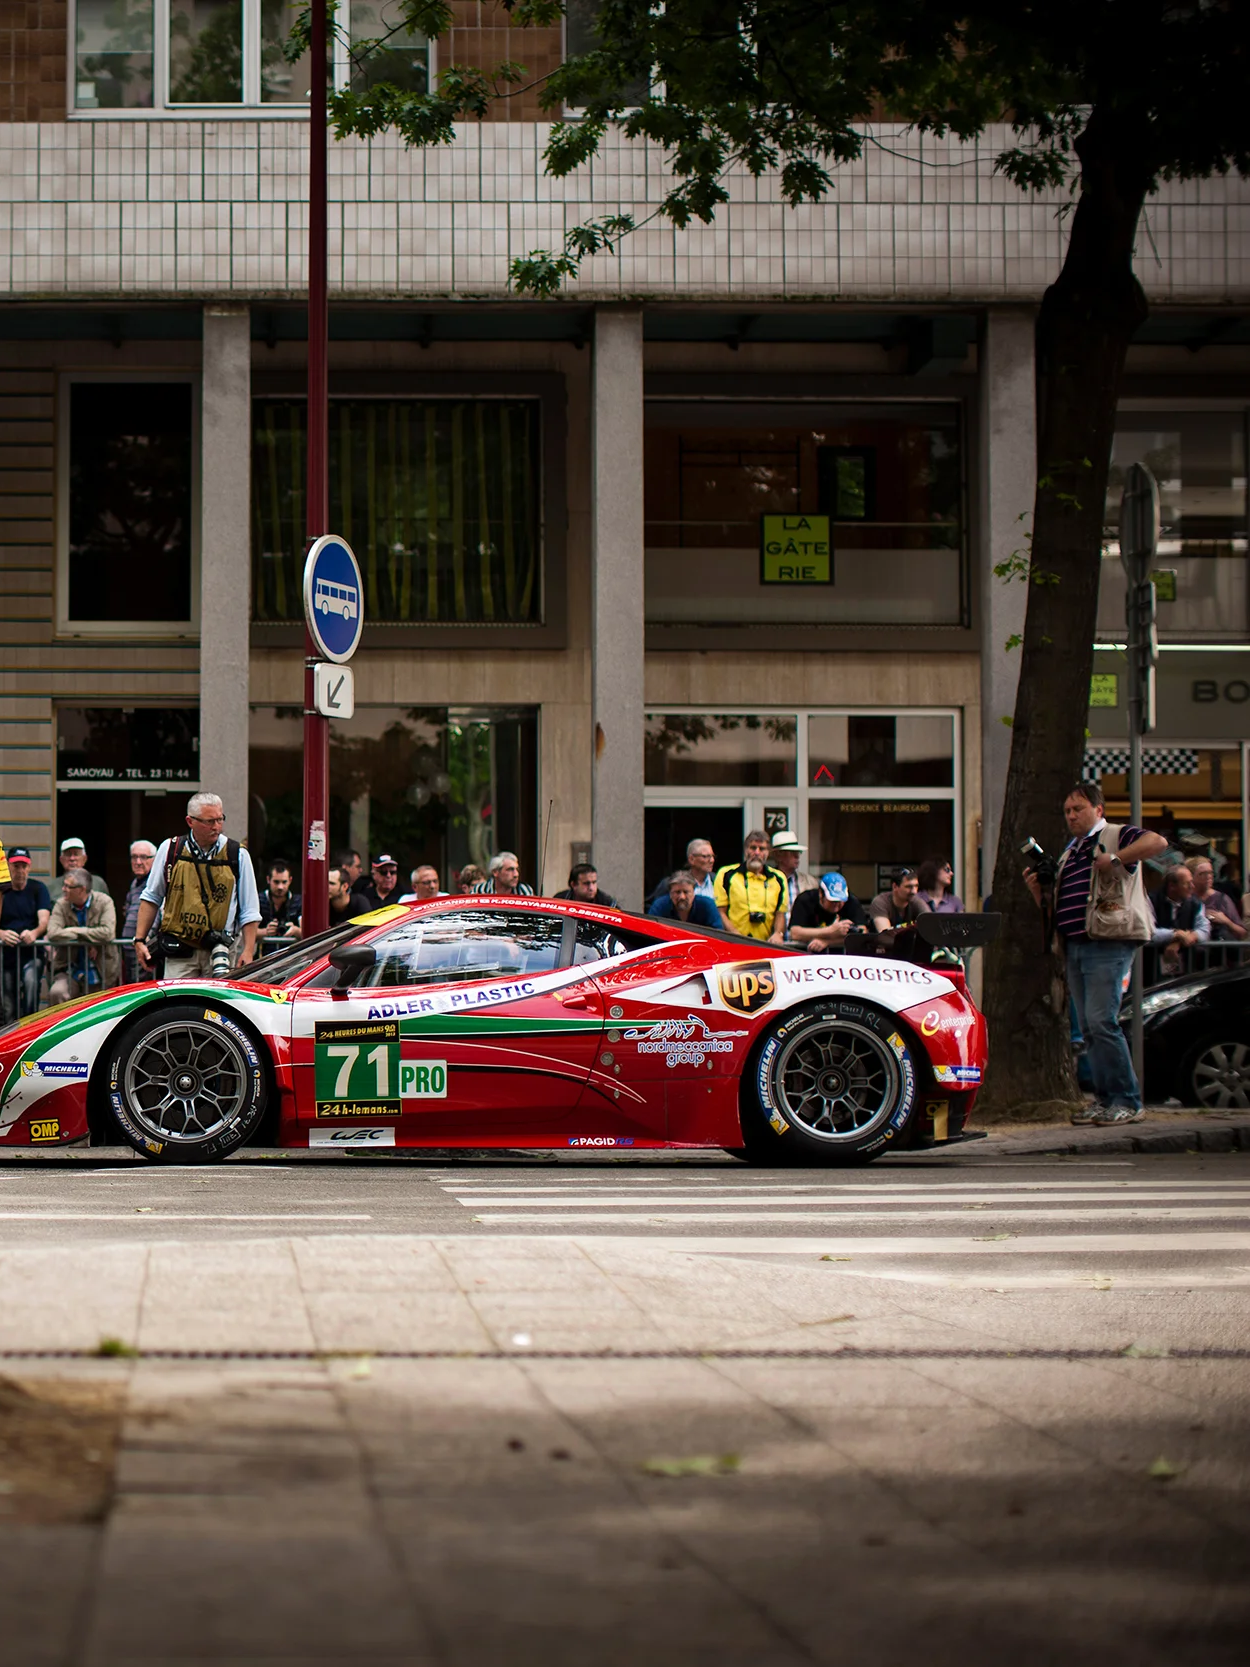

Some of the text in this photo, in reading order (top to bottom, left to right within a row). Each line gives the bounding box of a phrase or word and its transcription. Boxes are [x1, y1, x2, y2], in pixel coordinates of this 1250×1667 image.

[783, 517, 811, 530] LA
[766, 537, 828, 556] GÂTE
[778, 566, 817, 579] RIE
[67, 768, 114, 777] SAMOYAU
[840, 804, 879, 812] RESIDENCE
[766, 813, 787, 828] 73
[783, 967, 933, 985] WE LOGISTICS
[721, 972, 774, 1007] ups
[367, 983, 535, 1020] ADLER PLASTIC
[319, 1031, 334, 1040] 24
[334, 1028, 356, 1038] HEURES
[357, 1027, 366, 1035] DU
[367, 1025, 384, 1034] MANS
[224, 1020, 259, 1064] MICHELIN
[638, 1038, 733, 1053] nordmeccanica
[666, 1052, 705, 1068] group
[44, 1065, 88, 1073] MICHELIN
[327, 1044, 389, 1098] 71
[760, 1040, 777, 1108] MICHELIN
[401, 1066, 445, 1093] PRO
[897, 1059, 914, 1127] MICHELIN
[111, 1095, 143, 1145] MICHELIN
[31, 1123, 59, 1137] OMP
[330, 1129, 384, 1140] WEC
[580, 1137, 615, 1145] PAGID
